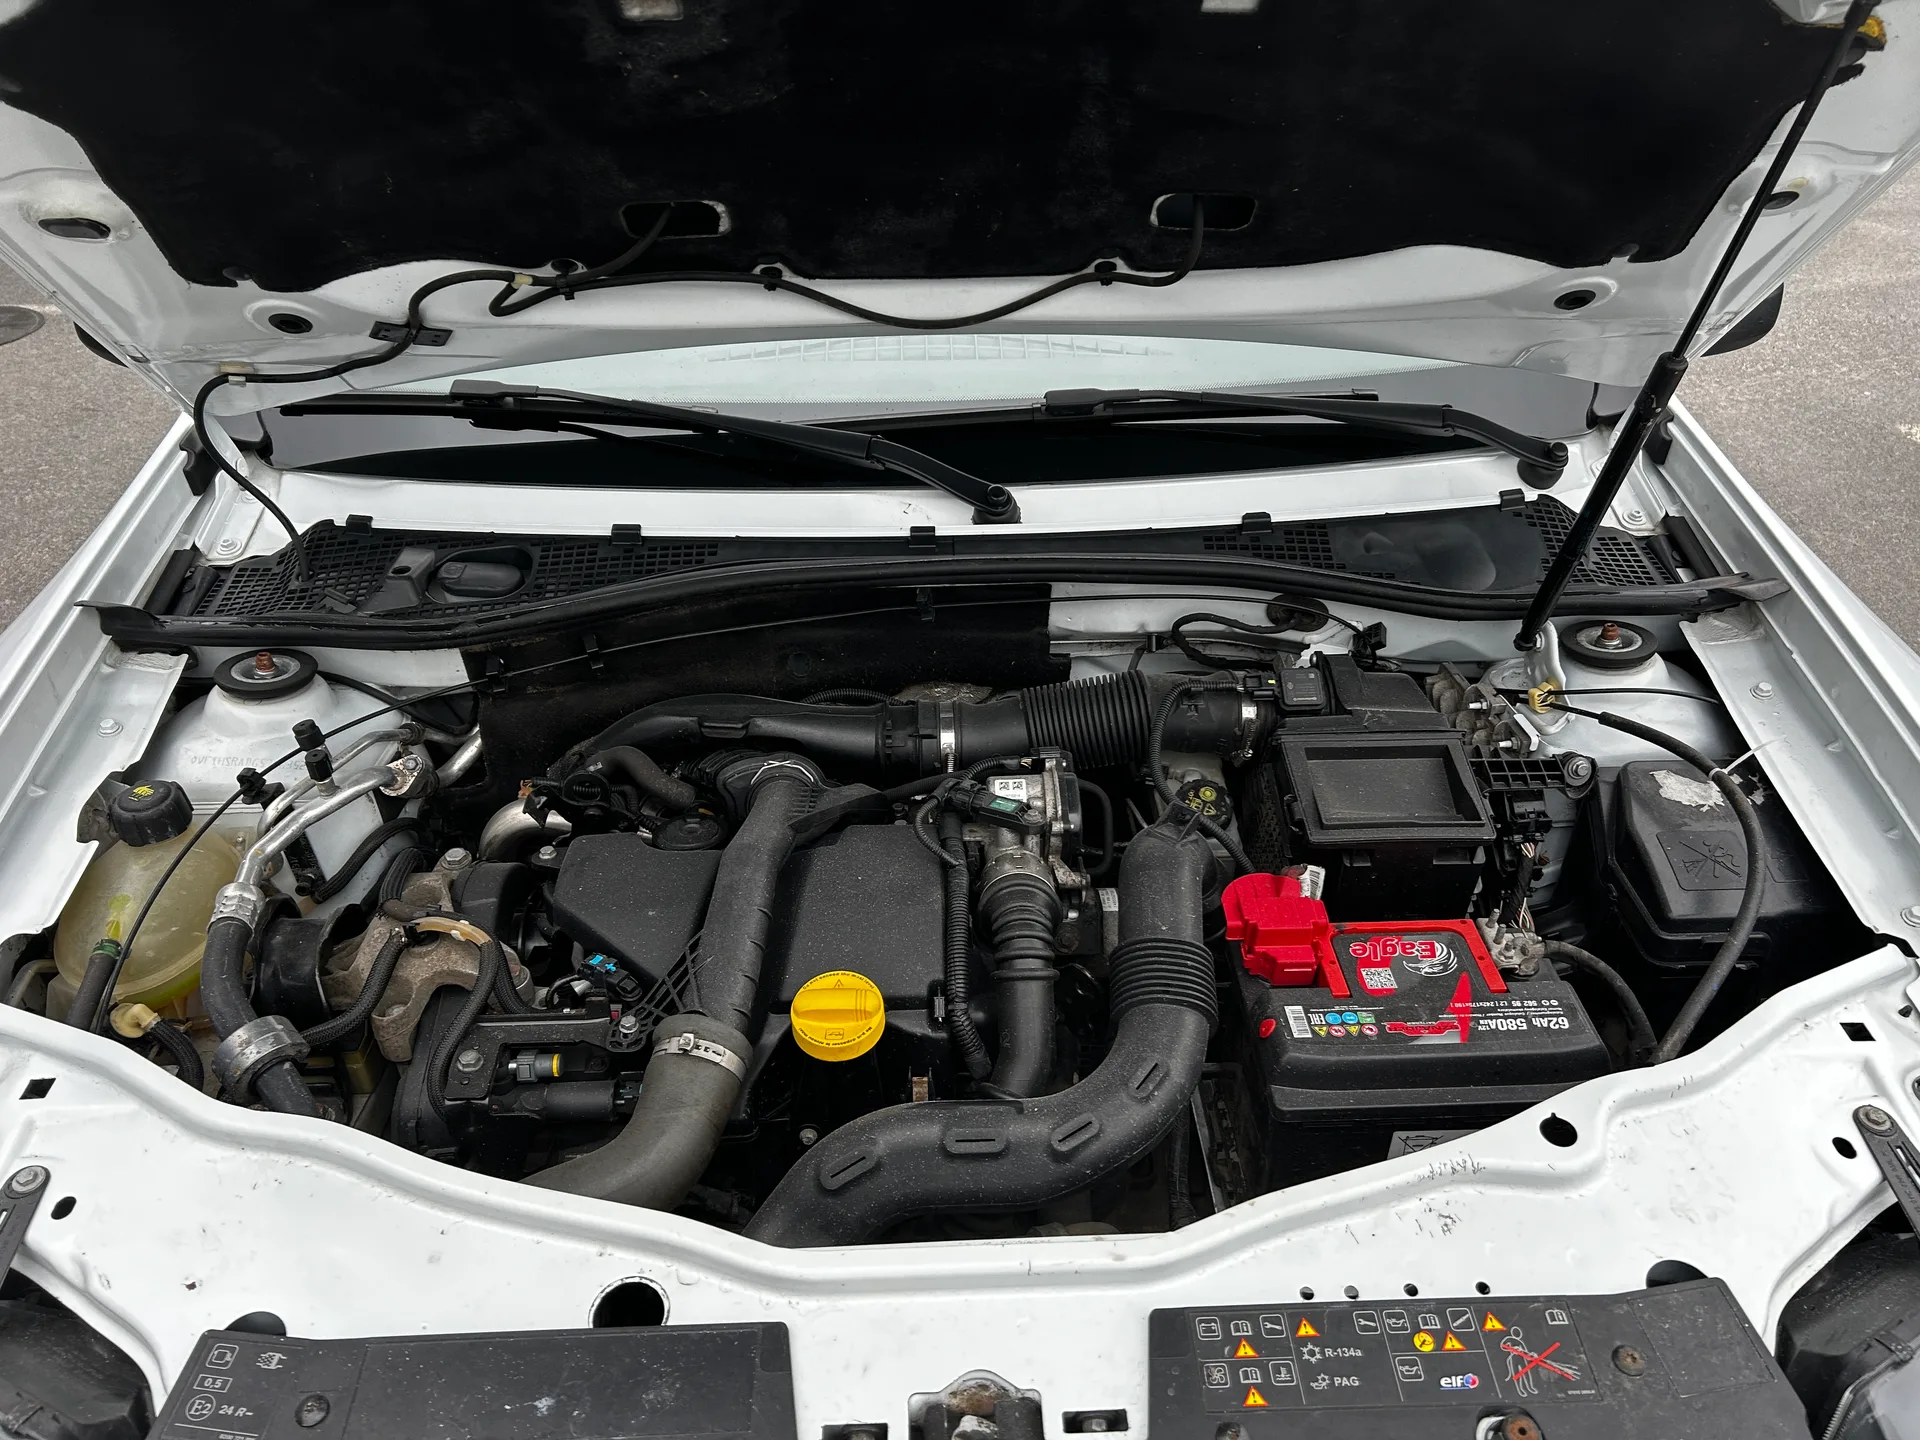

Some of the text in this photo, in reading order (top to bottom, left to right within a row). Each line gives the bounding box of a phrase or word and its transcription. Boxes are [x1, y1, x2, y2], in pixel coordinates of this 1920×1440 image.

[1348, 937, 1437, 961] Eagle
[1532, 1016, 1570, 1029] 62Ah
[1324, 1348, 1362, 1357] R-134a
[204, 1378, 223, 1388] 0,5
[1333, 1376, 1359, 1387] PAG
[189, 1399, 212, 1415] E2
[218, 1405, 234, 1415] 24
